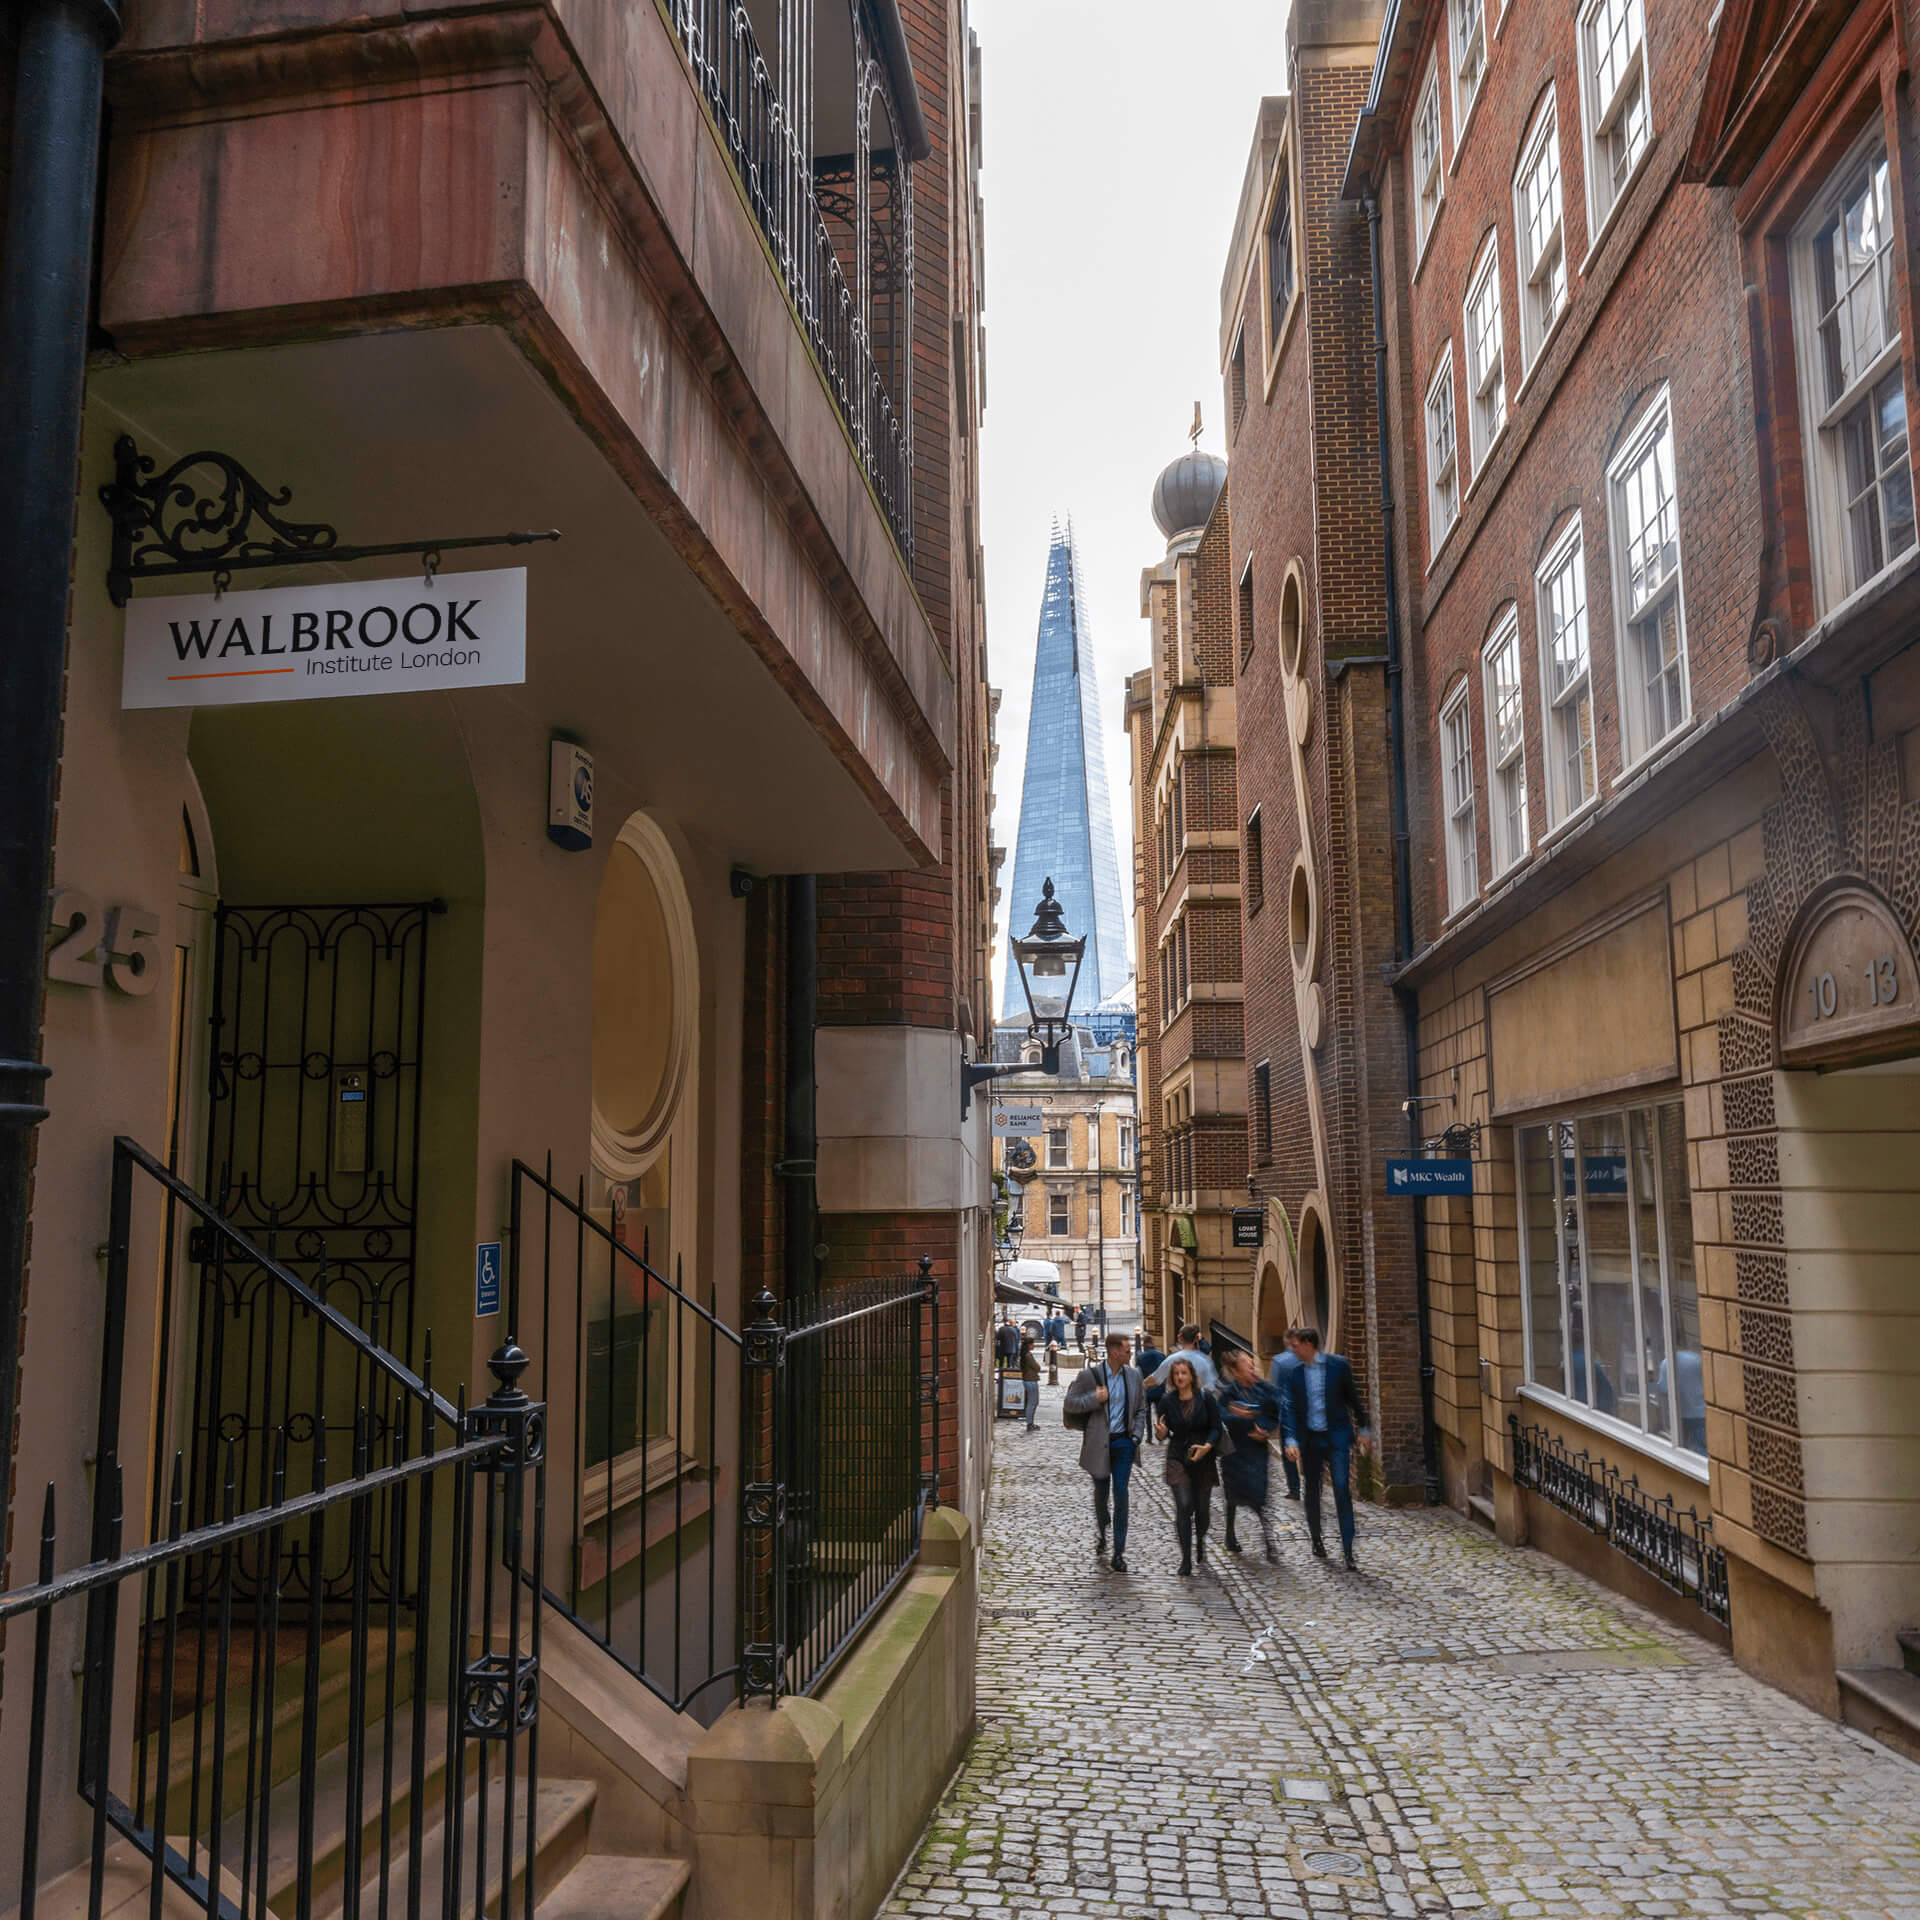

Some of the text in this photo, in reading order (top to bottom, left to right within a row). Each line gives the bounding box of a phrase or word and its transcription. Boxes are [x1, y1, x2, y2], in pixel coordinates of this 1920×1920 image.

[168, 599, 482, 661] WALBROOK
[306, 648, 481, 677] Institute London
[48, 891, 161, 996] 25
[1808, 956, 1899, 1020] 10 13
[1409, 1172, 1465, 1182] MKC Wealth
